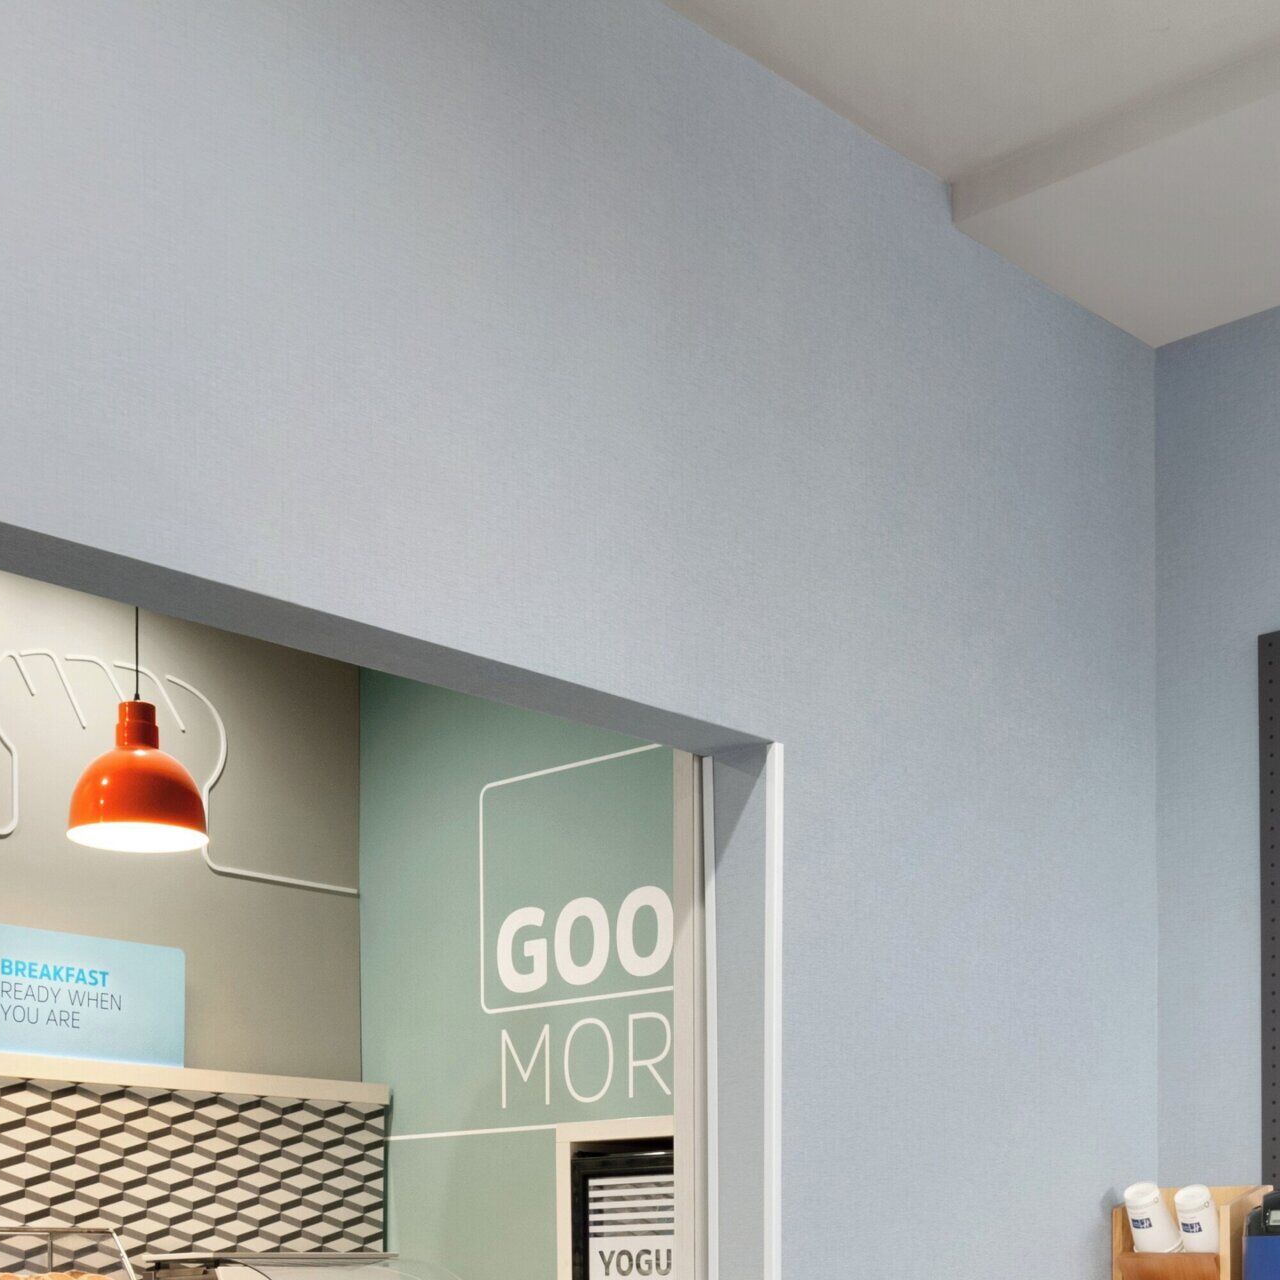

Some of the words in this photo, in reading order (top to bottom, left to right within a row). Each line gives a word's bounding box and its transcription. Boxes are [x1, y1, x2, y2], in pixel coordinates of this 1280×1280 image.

[497, 886, 673, 993] GOO
[0, 958, 109, 987] BREAKFAST
[0, 981, 61, 1004] READY
[68, 989, 121, 1011] WHEN
[0, 1003, 39, 1025] YOU
[46, 1009, 81, 1029] ARE
[502, 1012, 672, 1109] MOR
[598, 1248, 672, 1276] YOGU
